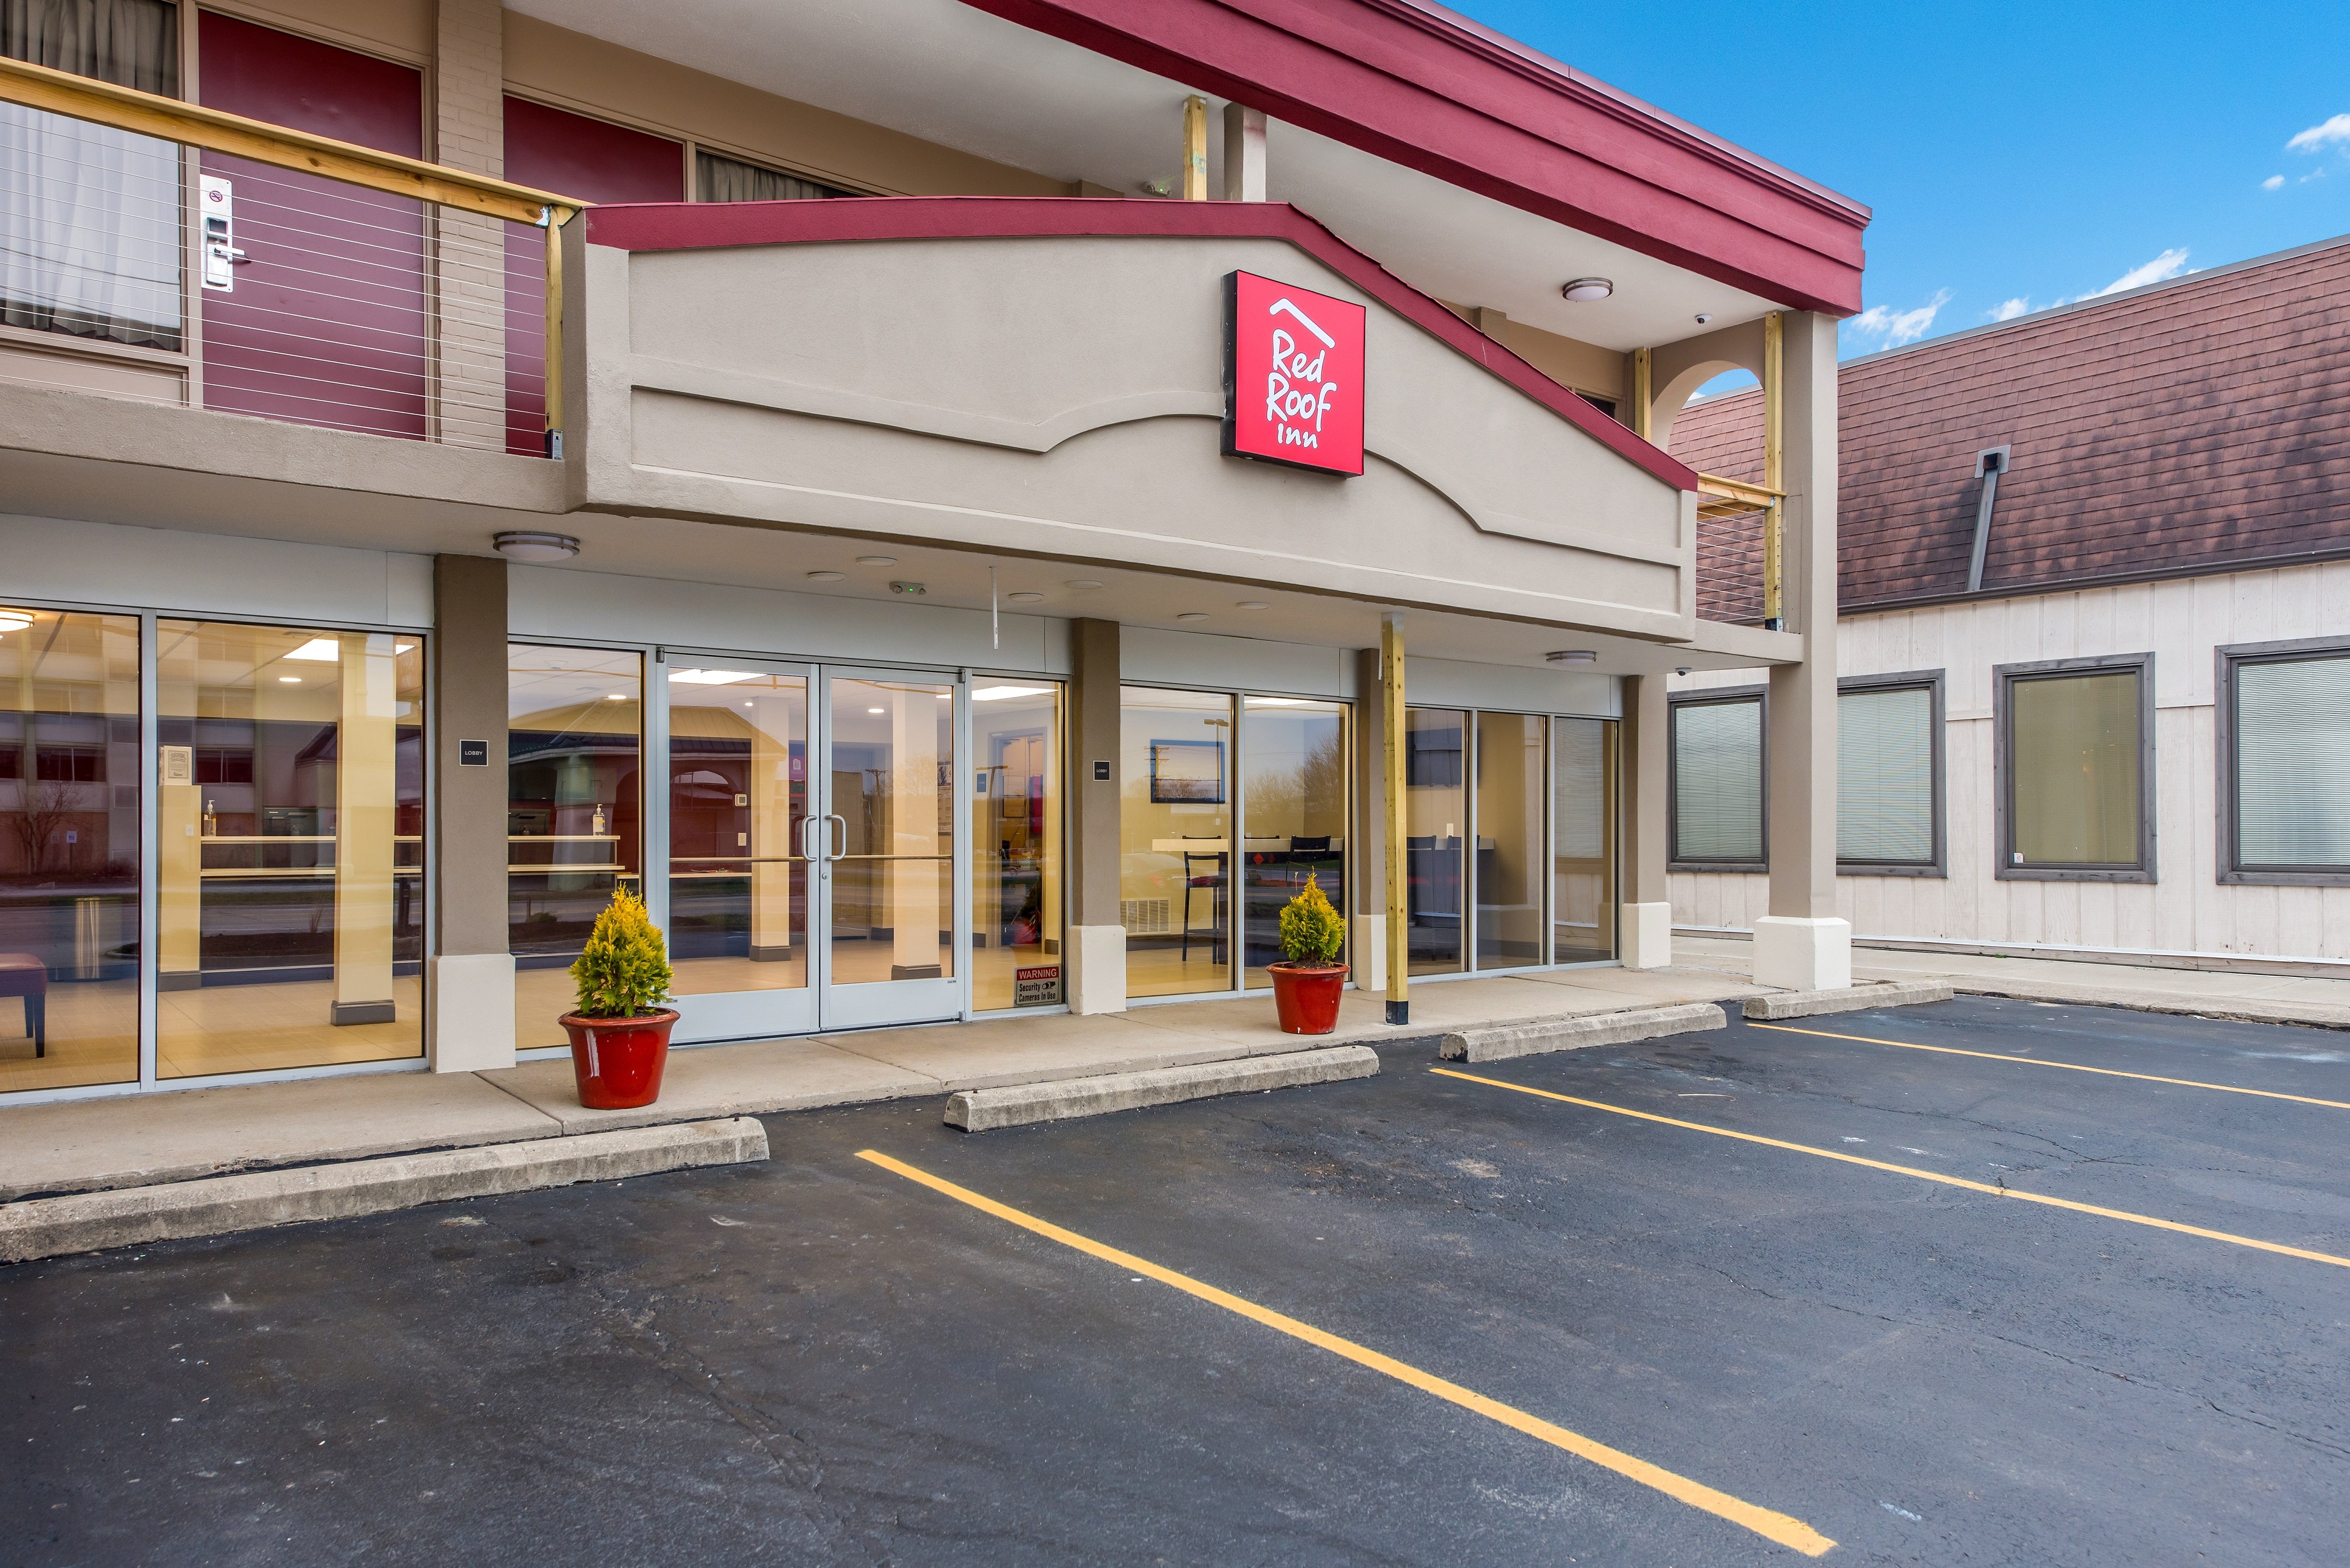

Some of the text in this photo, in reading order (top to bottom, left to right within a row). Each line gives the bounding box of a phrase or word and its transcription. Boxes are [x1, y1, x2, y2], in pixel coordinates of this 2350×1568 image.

[1273, 328, 1325, 383] Red
[1266, 371, 1337, 432] Roof
[1019, 969, 1057, 980] WARNING
[1019, 983, 1041, 992] Security
[1019, 994, 1040, 1002] Cameras
